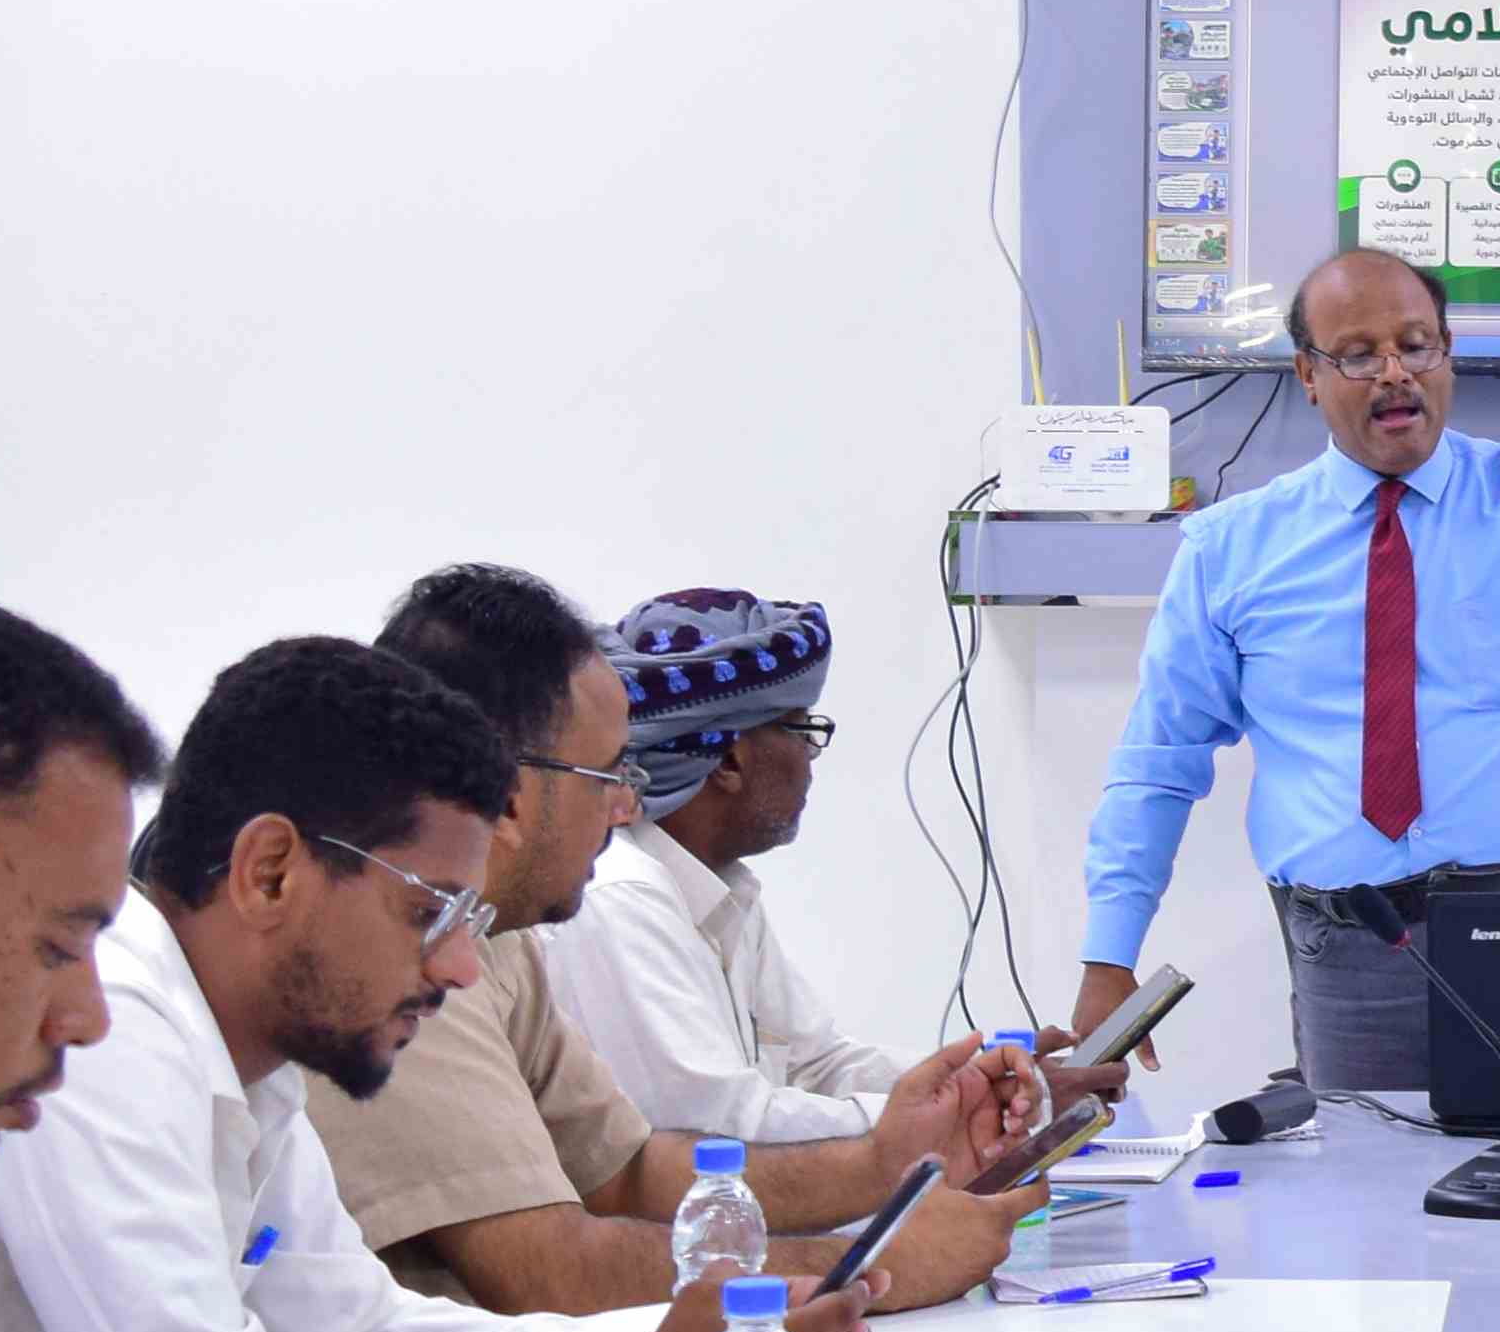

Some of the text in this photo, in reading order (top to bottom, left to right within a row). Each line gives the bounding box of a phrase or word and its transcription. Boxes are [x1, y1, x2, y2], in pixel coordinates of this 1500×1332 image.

[1430, 66, 1478, 80] التواصل
[1457, 90, 1495, 103] تشمل
[1440, 112, 1493, 126] والرسائل
[1375, 200, 1431, 212] المنشورات
[1455, 202, 1493, 214] القصيرة
